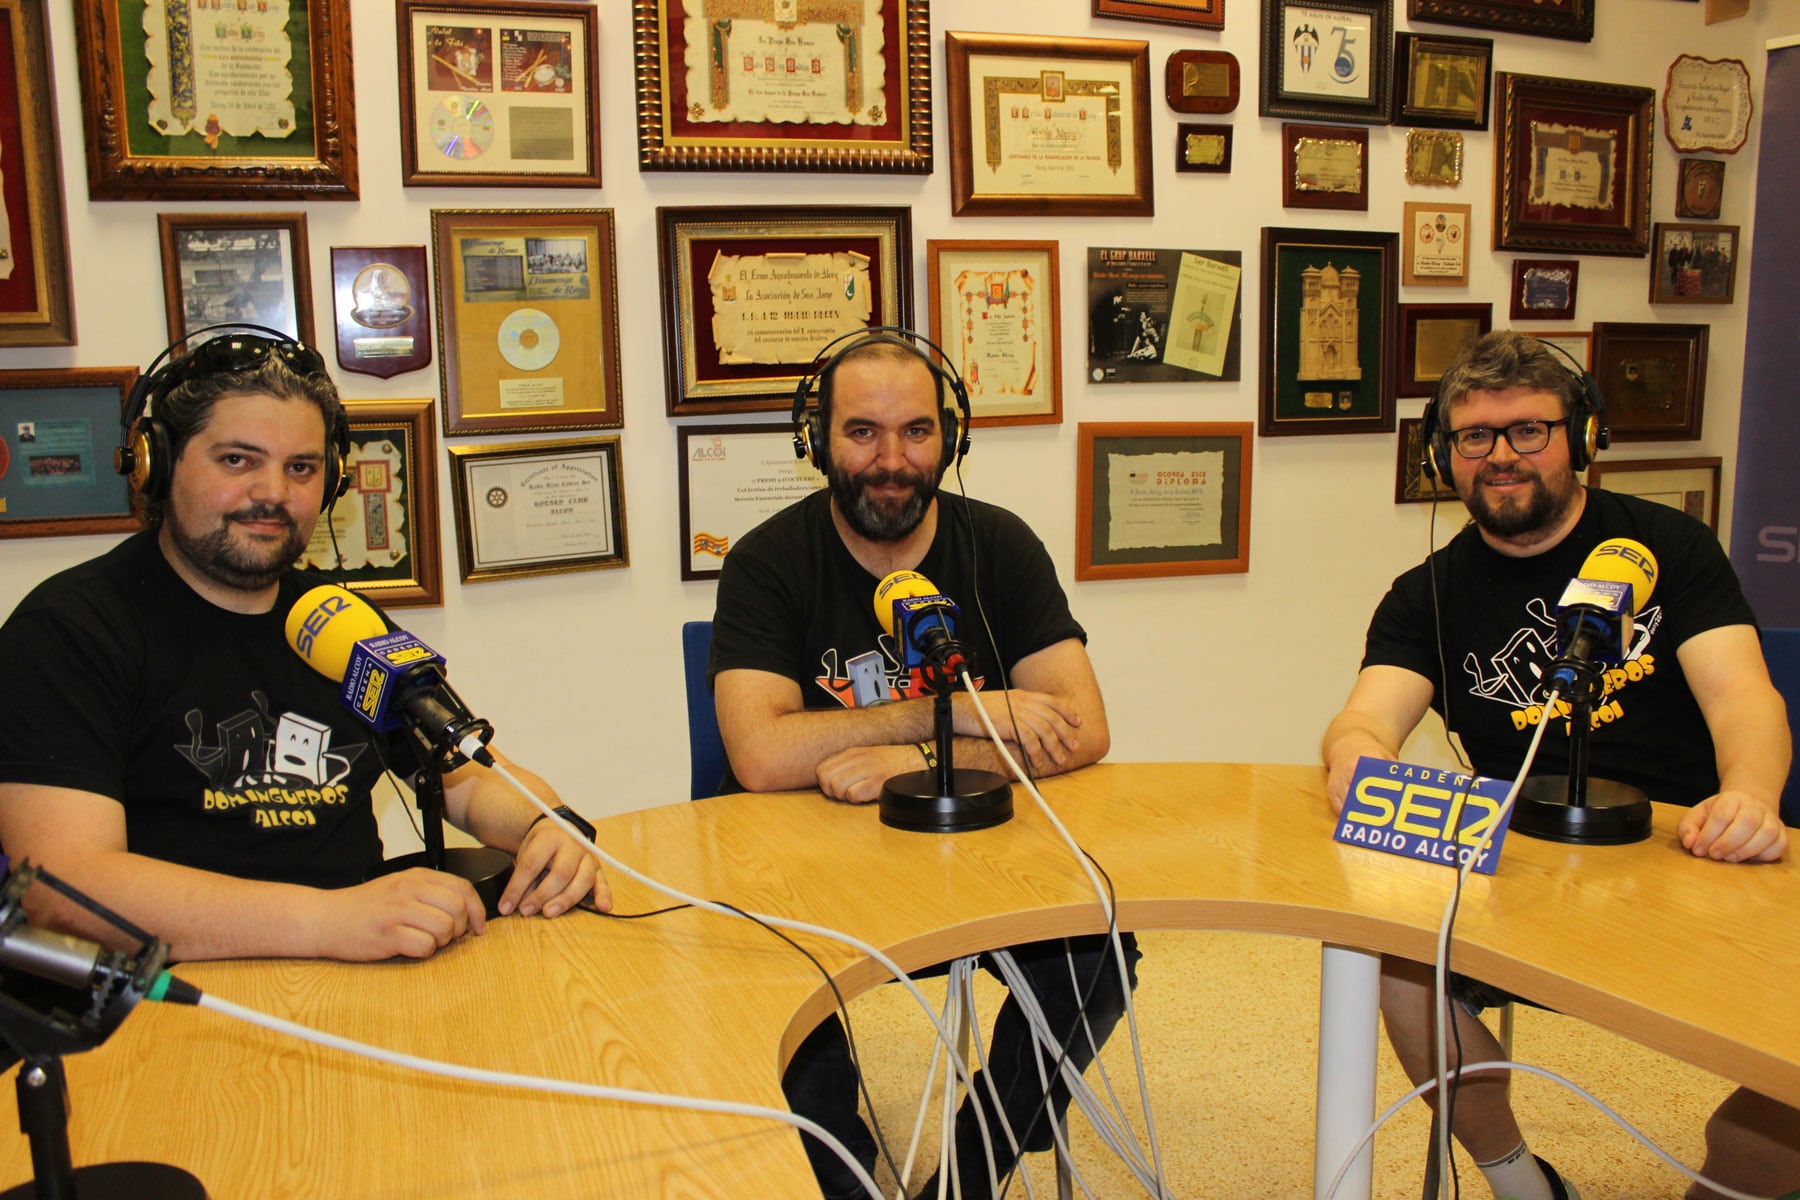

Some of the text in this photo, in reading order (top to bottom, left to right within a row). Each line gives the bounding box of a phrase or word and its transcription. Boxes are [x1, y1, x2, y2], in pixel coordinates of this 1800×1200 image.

[1595, 544, 1655, 584] SER
[296, 595, 352, 659] SER
[368, 634, 409, 649] RADIO ALCOY
[345, 654, 363, 702] RADIO ALCOY
[357, 662, 373, 709] CADENA
[362, 668, 386, 719] SER
[204, 784, 349, 810] DOMINGUEROS
[1389, 764, 1480, 790] CADENA
[255, 809, 316, 828] ALCOI
[1346, 776, 1501, 850] SER
[1341, 823, 1489, 868] RADIO ALCOY
